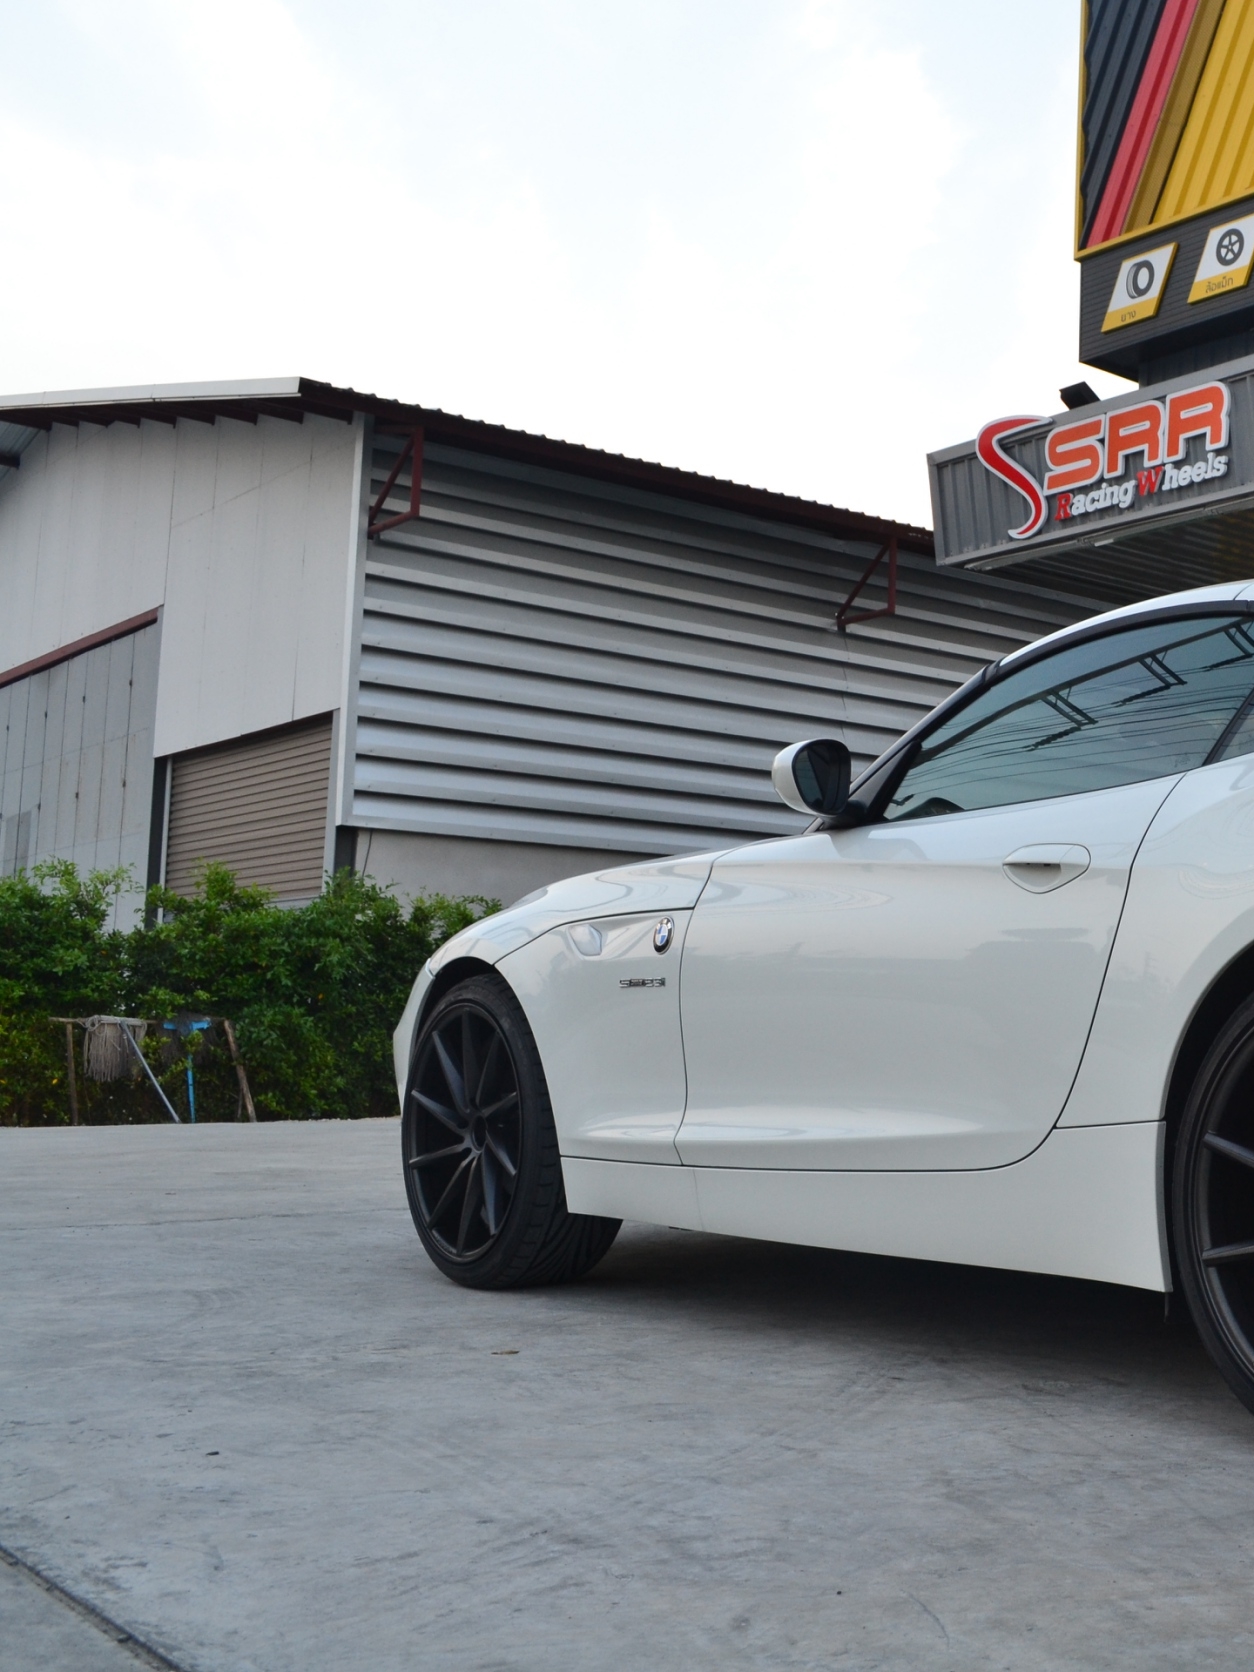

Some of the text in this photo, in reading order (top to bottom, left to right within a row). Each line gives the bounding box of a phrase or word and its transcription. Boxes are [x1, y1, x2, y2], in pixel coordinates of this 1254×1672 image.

[1120, 309, 1137, 323] ยาง
[1054, 452, 1230, 522] Racing Wheels
